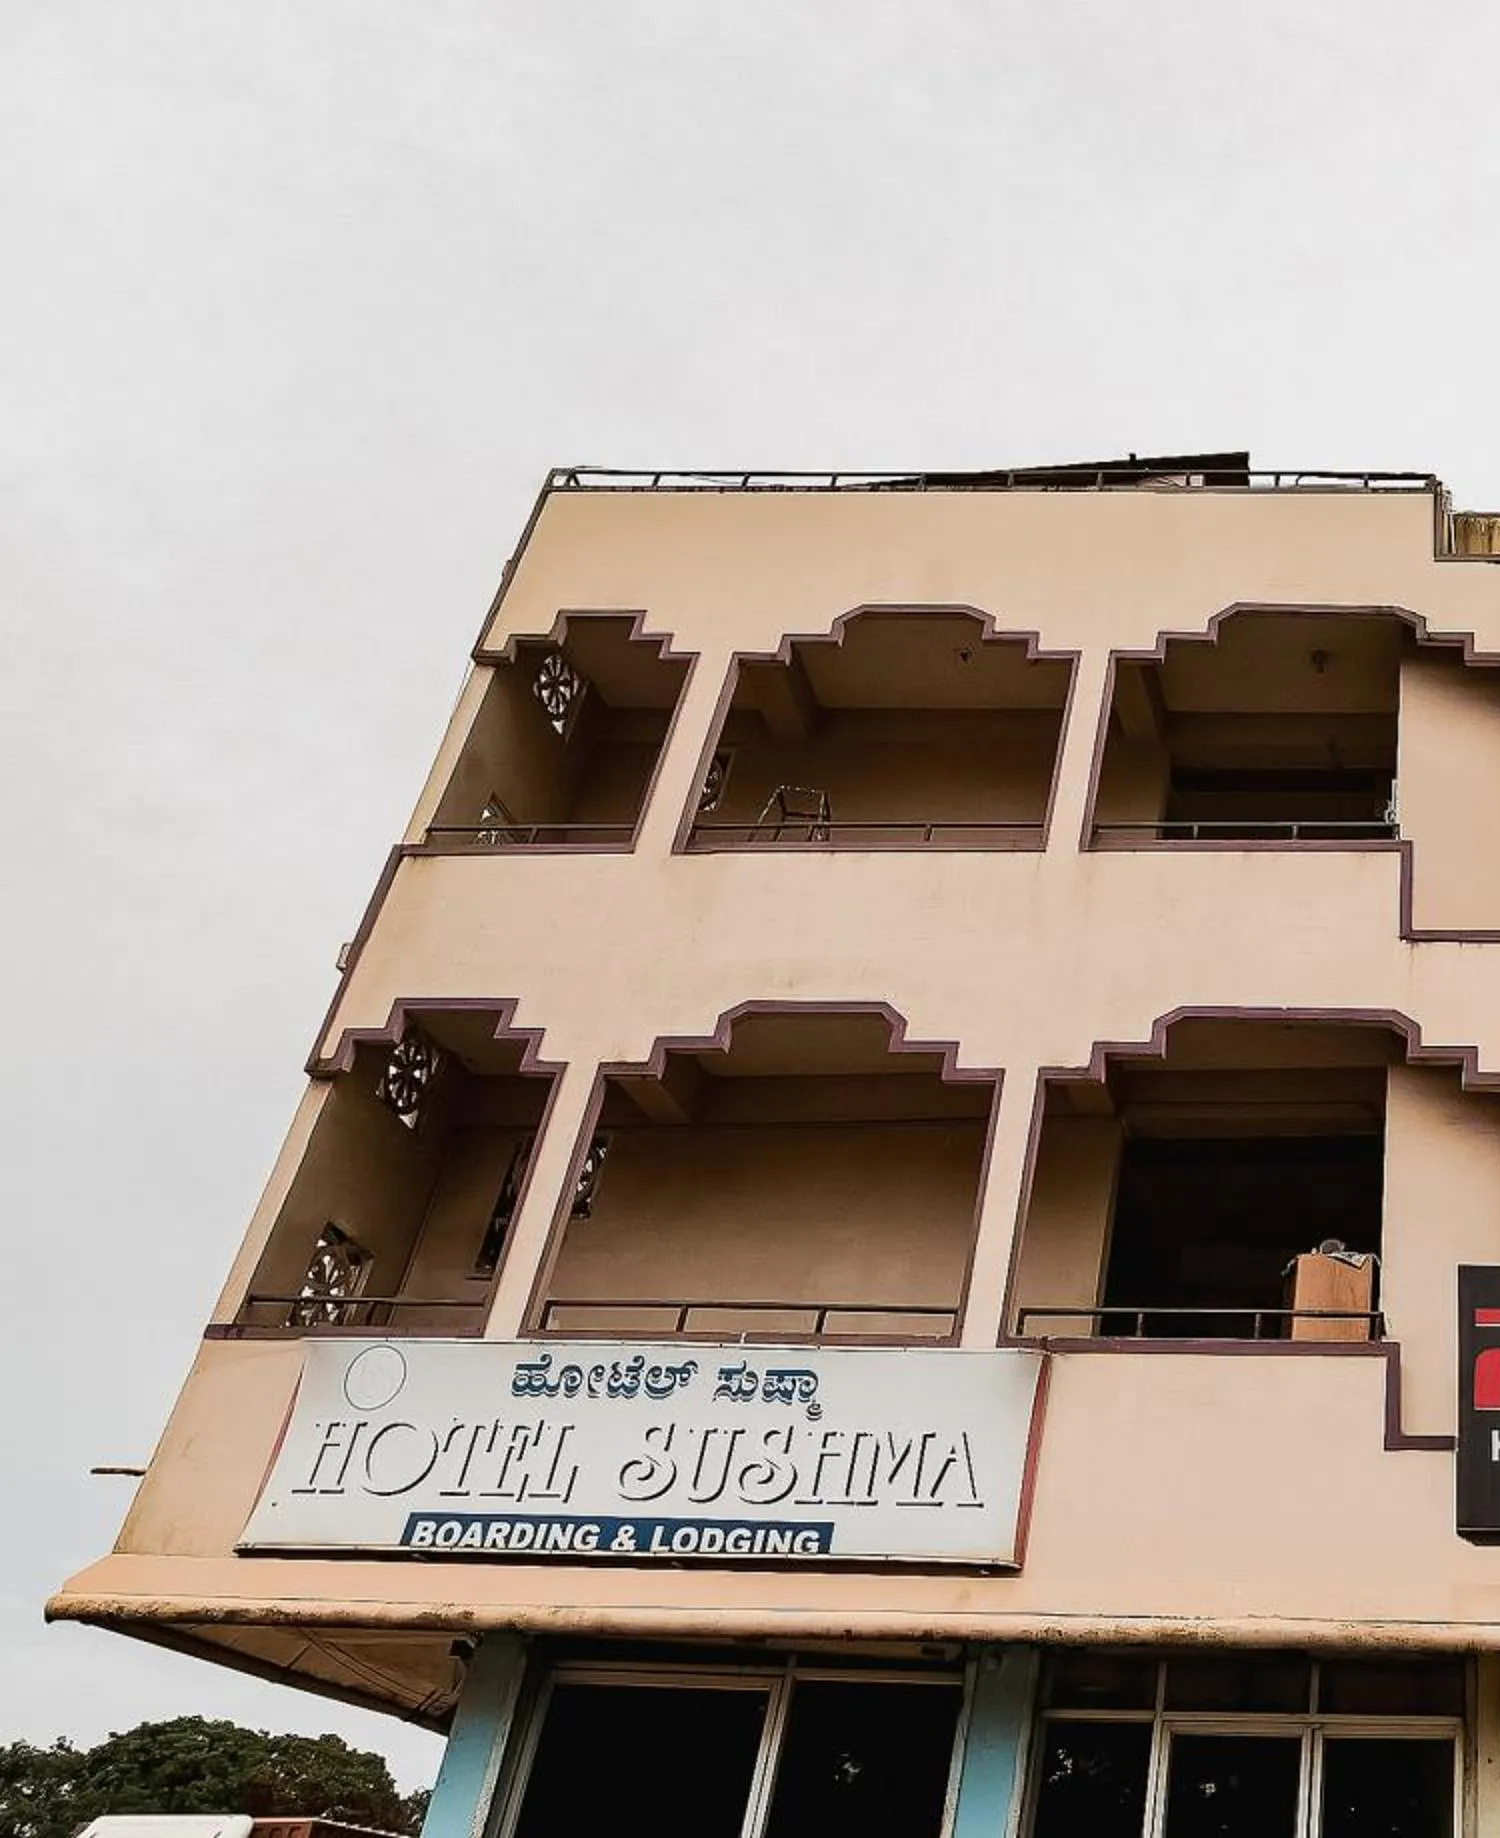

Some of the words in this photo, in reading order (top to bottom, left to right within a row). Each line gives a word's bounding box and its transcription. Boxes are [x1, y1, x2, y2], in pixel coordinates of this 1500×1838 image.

[511, 1353, 699, 1401] ಹೋಟೆಲ್
[713, 1359, 824, 1421] ಸುಷ್ಮಾ
[291, 1418, 580, 1505] HOTEL
[615, 1422, 985, 1509] SUSHMA
[410, 1520, 601, 1553] BOARDING
[610, 1525, 638, 1553] &
[649, 1525, 822, 1555] LODGING
